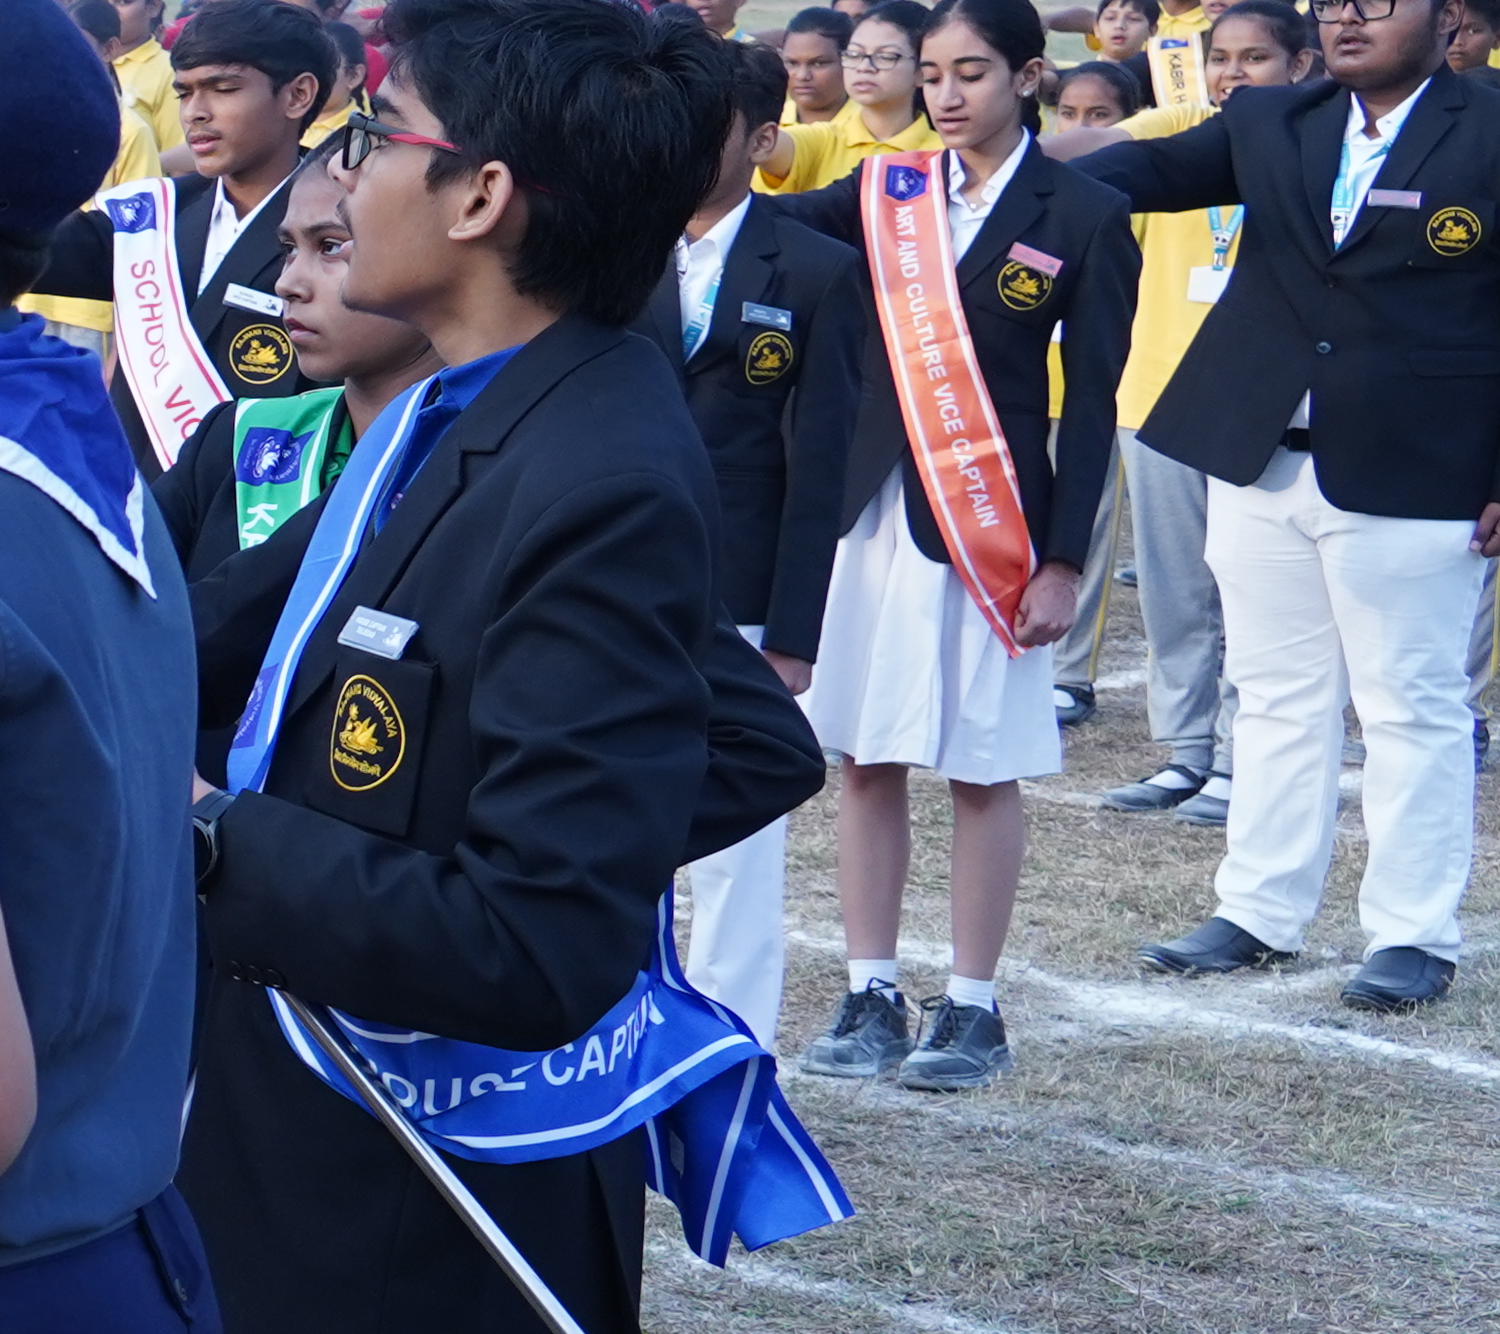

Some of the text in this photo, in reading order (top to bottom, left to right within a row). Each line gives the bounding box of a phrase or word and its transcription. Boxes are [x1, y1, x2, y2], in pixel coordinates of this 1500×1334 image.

[130, 259, 203, 441] SCHOOL VIC
[895, 205, 1000, 528] ART AND CULTURE VICE CAPTAIN
